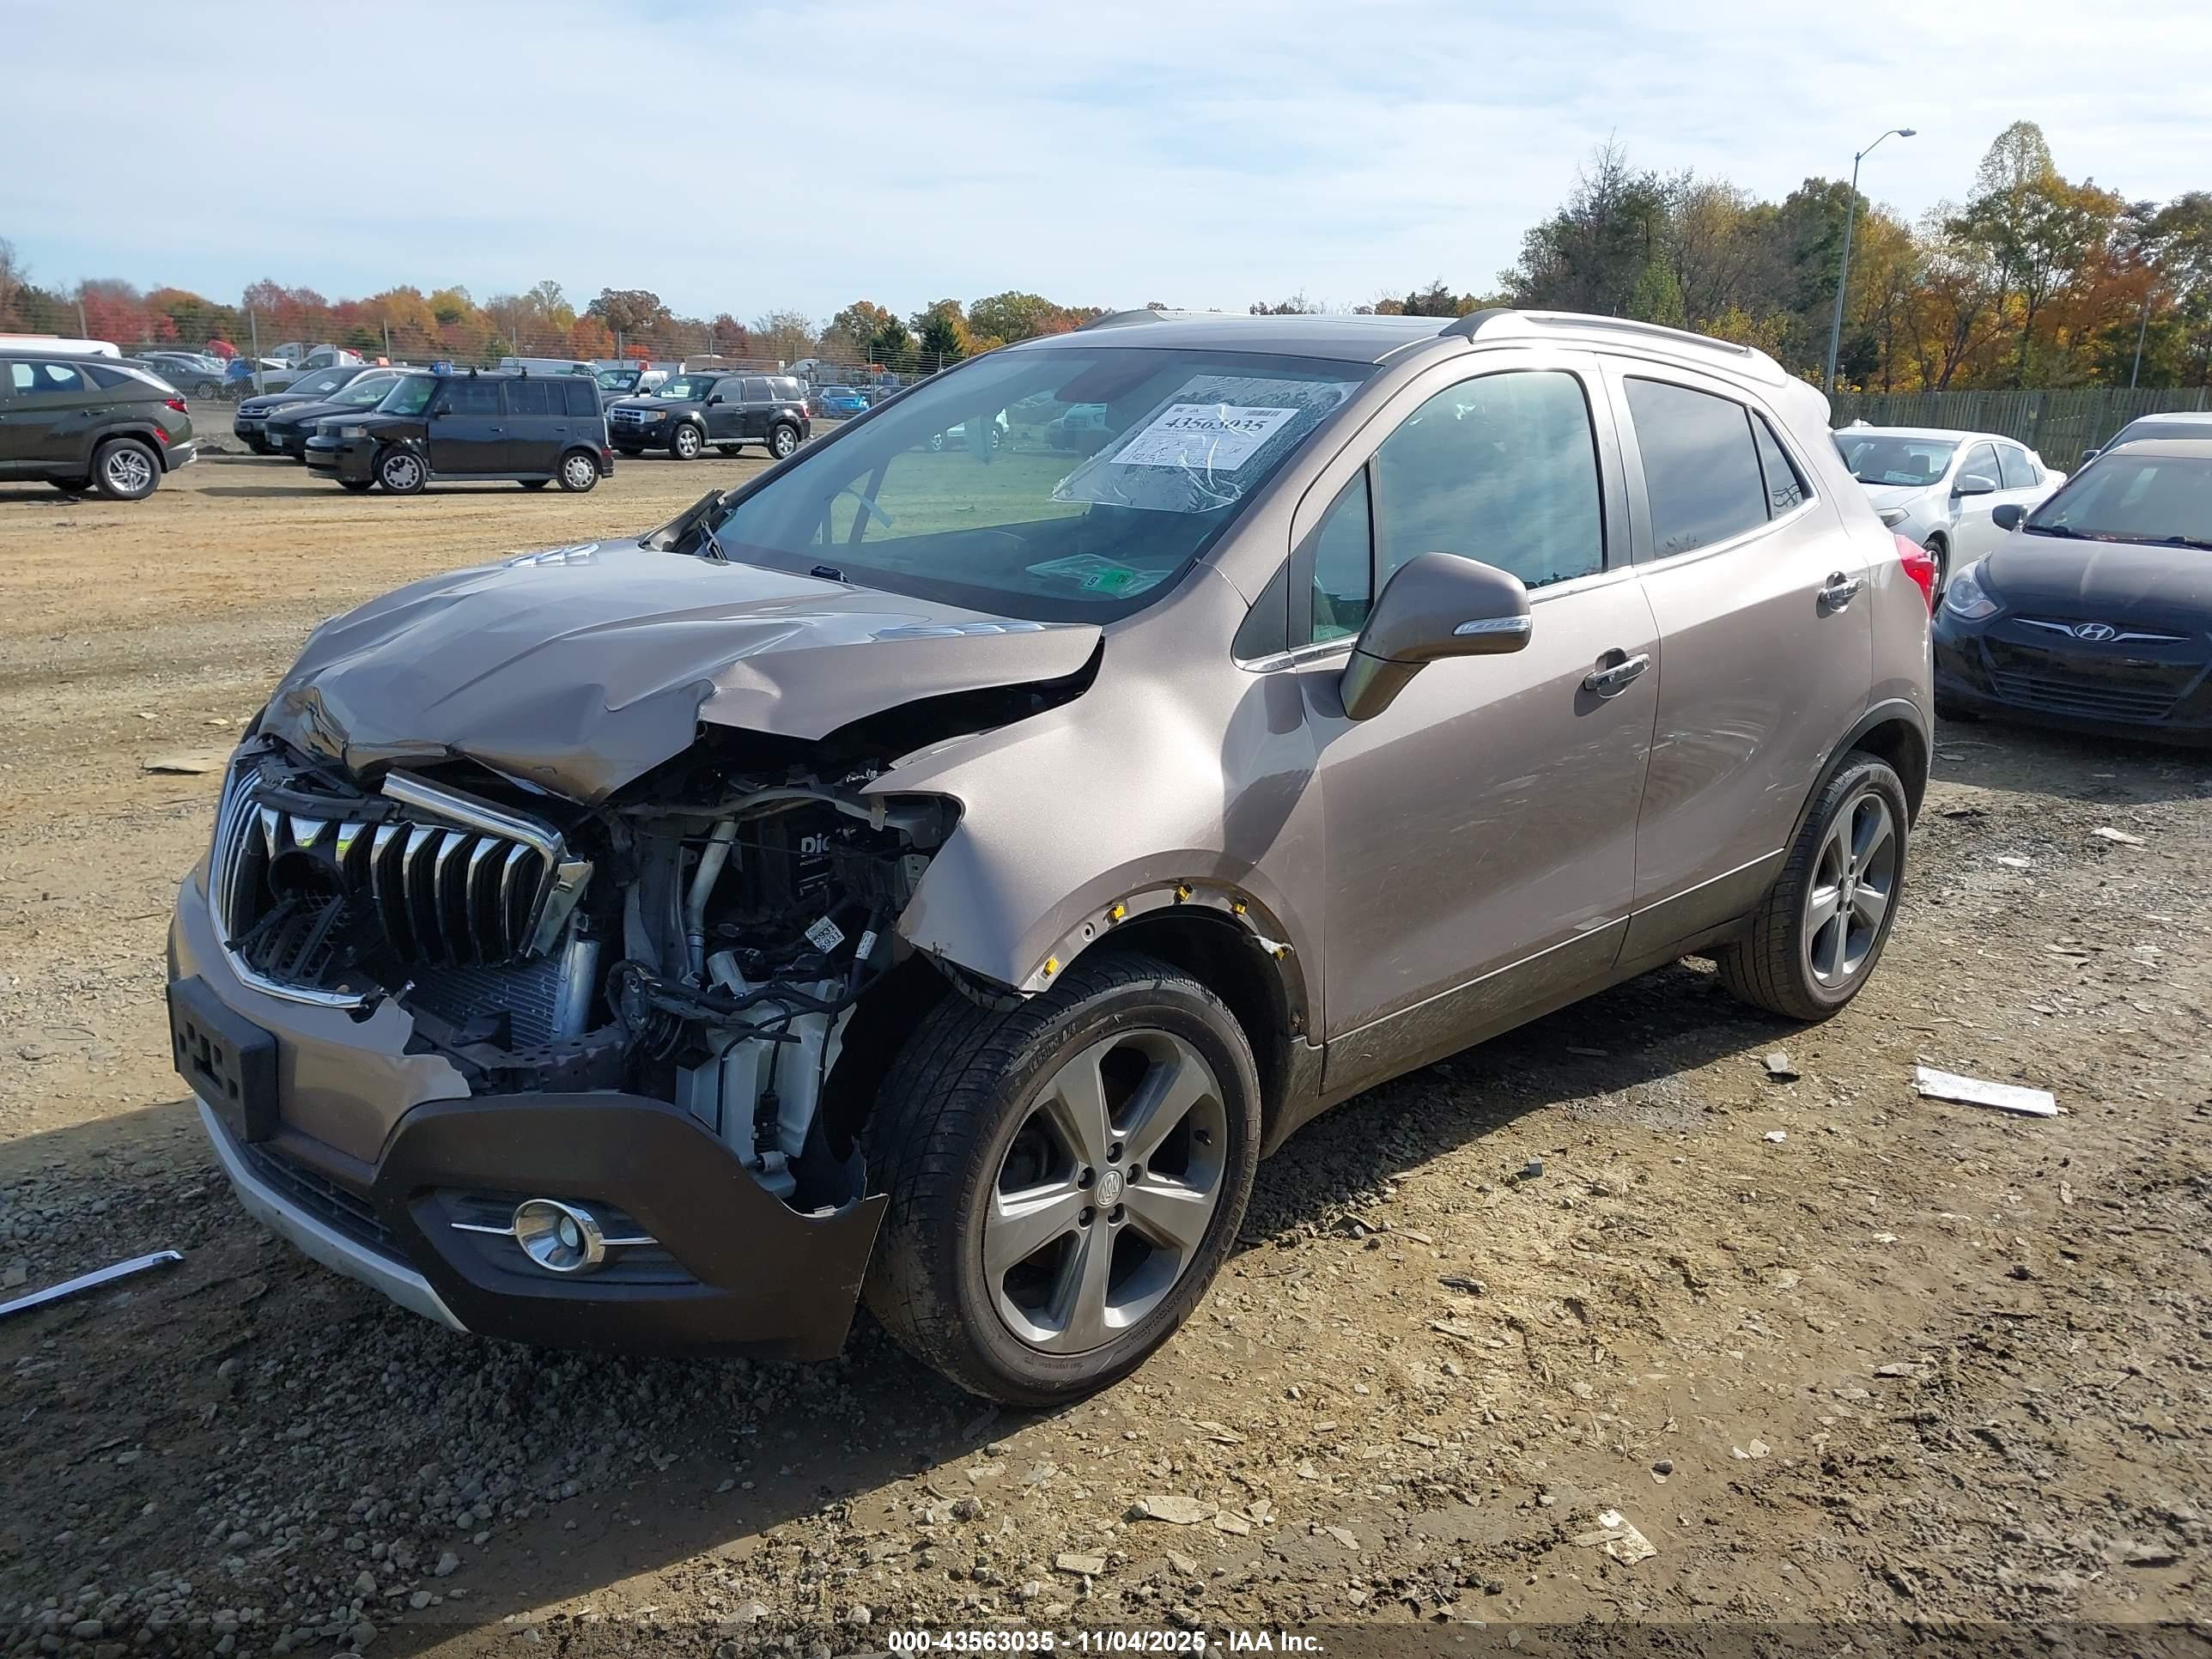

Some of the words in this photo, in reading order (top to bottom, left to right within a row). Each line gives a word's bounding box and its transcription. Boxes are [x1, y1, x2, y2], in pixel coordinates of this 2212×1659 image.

[1165, 416, 1269, 432] 43563035
[1087, 576, 1099, 586] 9
[819, 932, 842, 951] 5931
